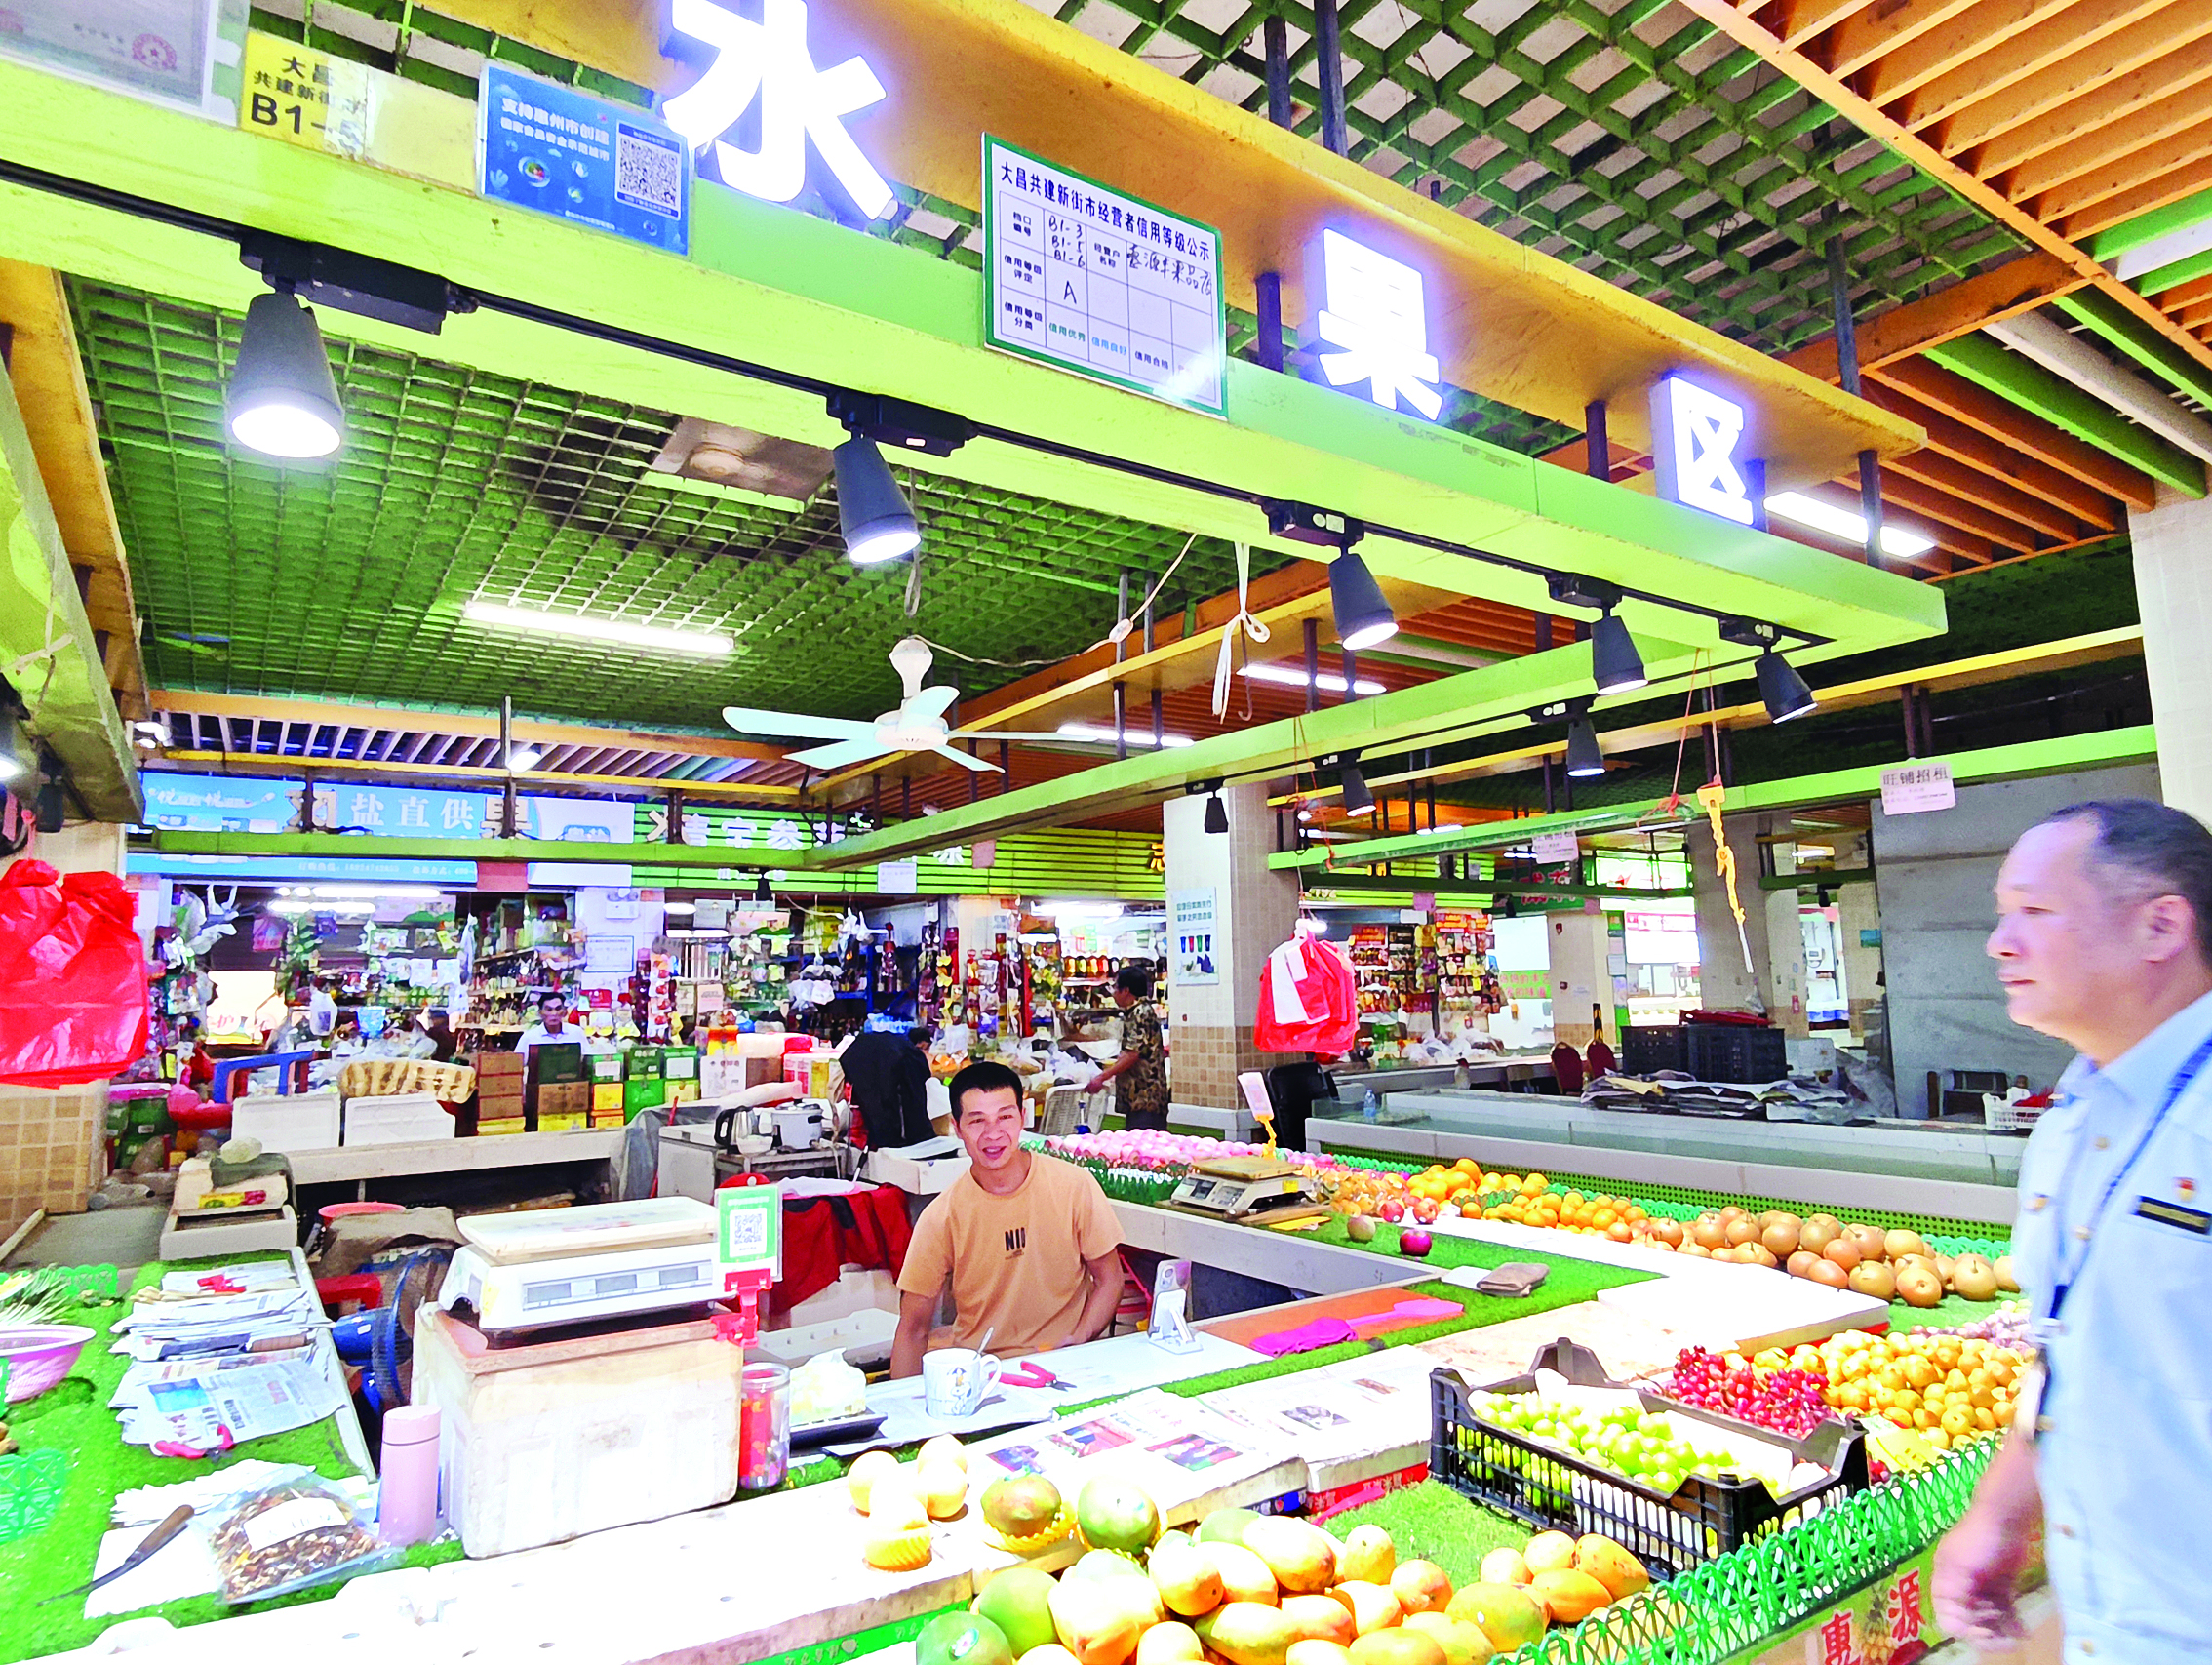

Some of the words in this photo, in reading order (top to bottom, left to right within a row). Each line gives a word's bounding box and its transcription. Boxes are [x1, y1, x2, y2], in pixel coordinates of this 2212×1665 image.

[253, 70, 363, 114] 共建新街
[1001, 161, 1210, 261] 大昌共建新街市经营者信用等级公示
[662, 0, 1753, 526] 水果区
[1063, 280, 1077, 304] A
[350, 792, 475, 830] 盐直供
